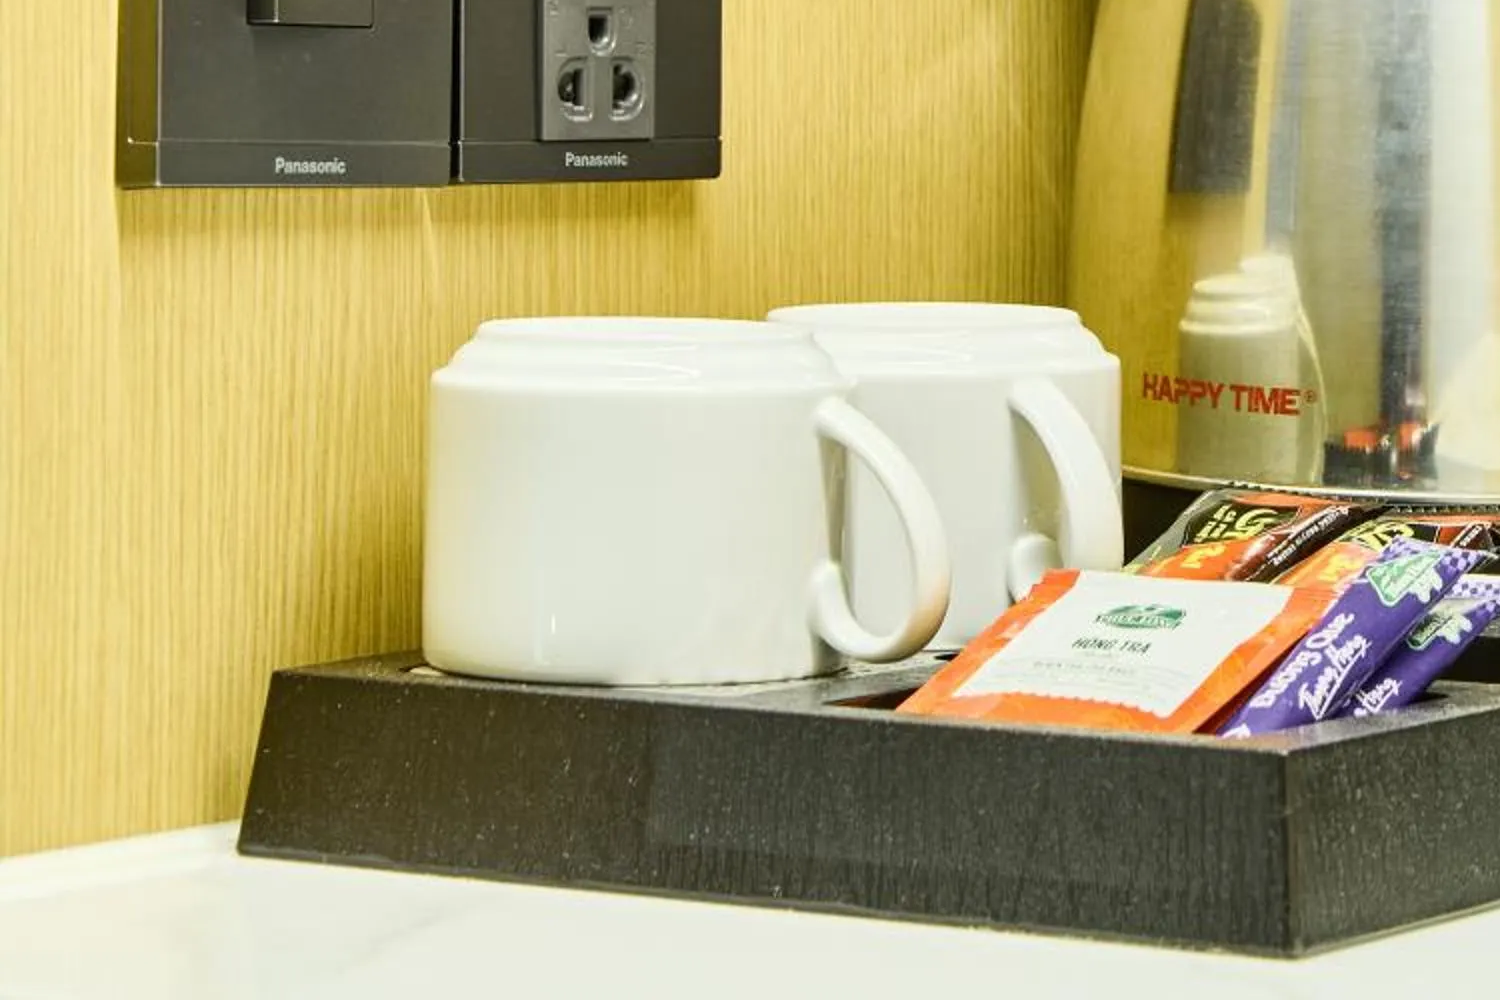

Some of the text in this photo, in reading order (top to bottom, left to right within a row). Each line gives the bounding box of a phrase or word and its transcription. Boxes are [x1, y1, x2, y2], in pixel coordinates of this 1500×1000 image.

[275, 156, 347, 174] Panasonic
[565, 151, 629, 167] Panasonic
[1143, 373, 1301, 416] HAPPY TIME
